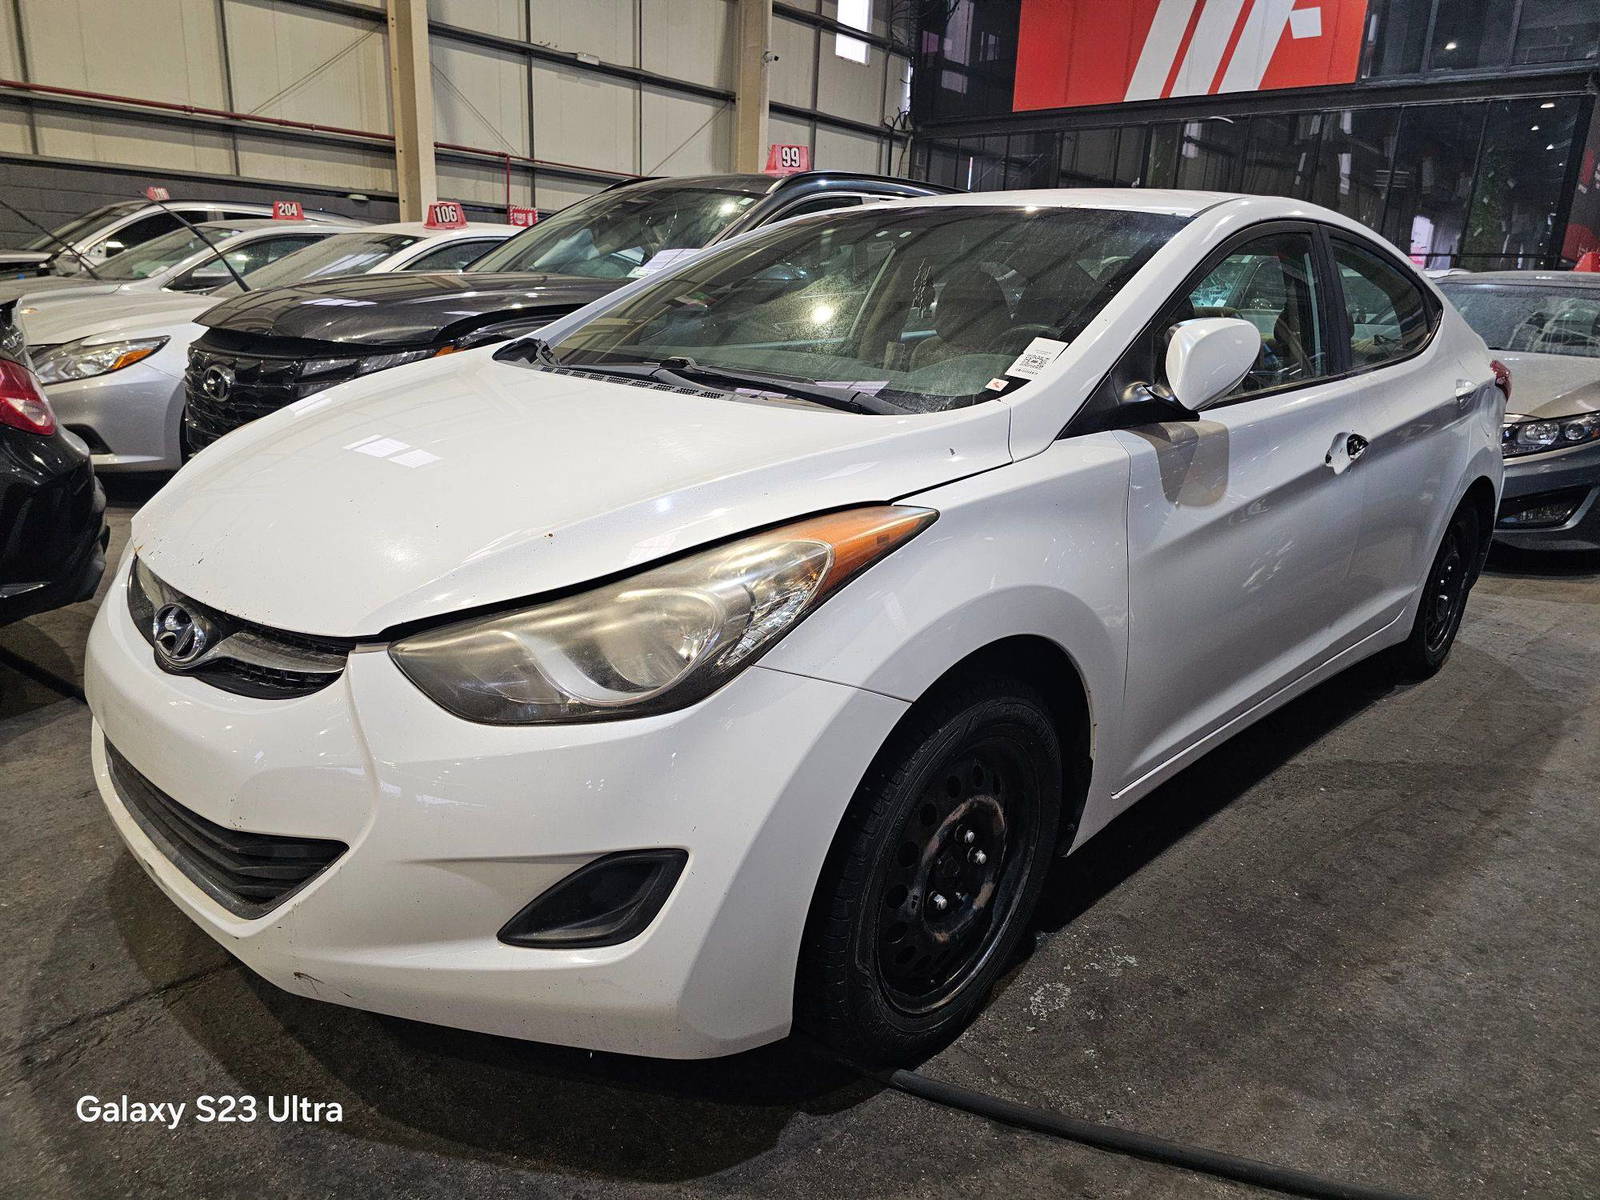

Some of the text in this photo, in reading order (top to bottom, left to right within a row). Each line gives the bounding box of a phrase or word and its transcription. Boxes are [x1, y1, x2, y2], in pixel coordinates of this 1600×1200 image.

[782, 146, 800, 167] 99
[278, 202, 298, 216] 204
[435, 205, 458, 223] 106
